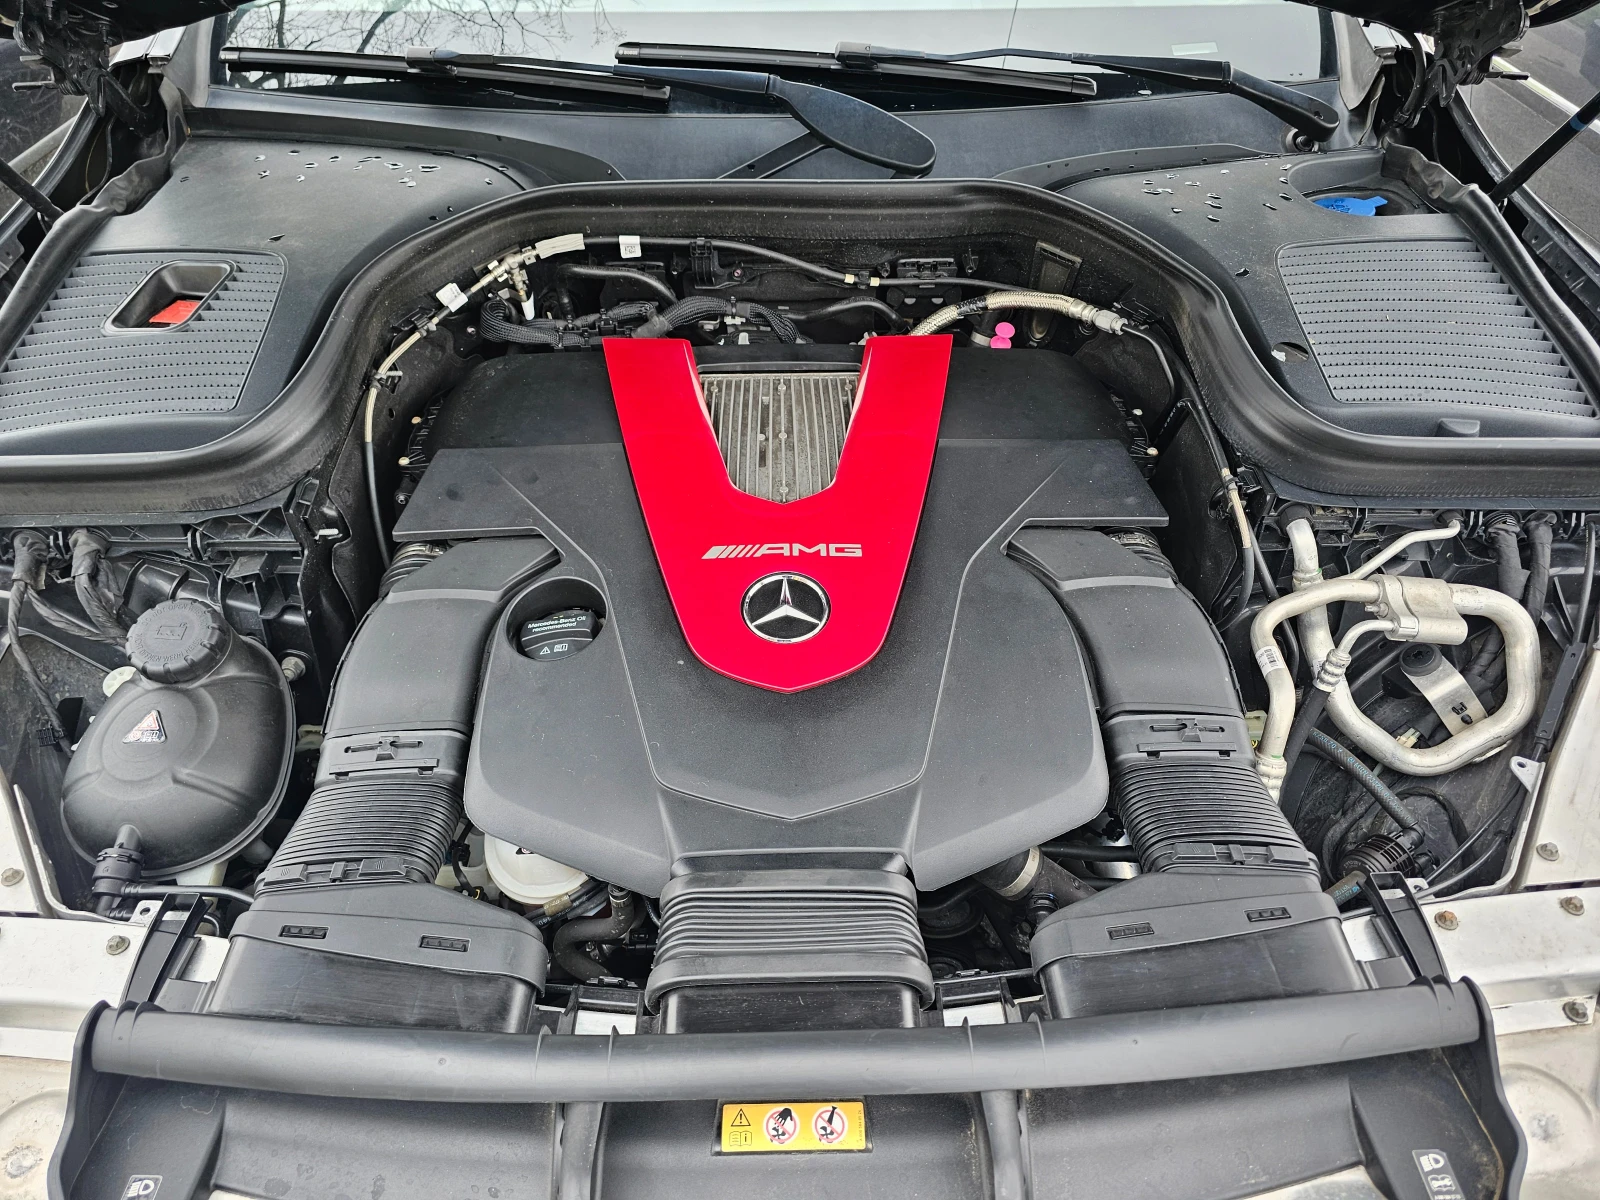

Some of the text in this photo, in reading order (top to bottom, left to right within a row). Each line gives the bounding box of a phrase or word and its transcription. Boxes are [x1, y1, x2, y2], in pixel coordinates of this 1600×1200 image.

[753, 543, 863, 558] AMG
[528, 618, 576, 628] Mercedes-Benz
[532, 622, 577, 632] recommended
